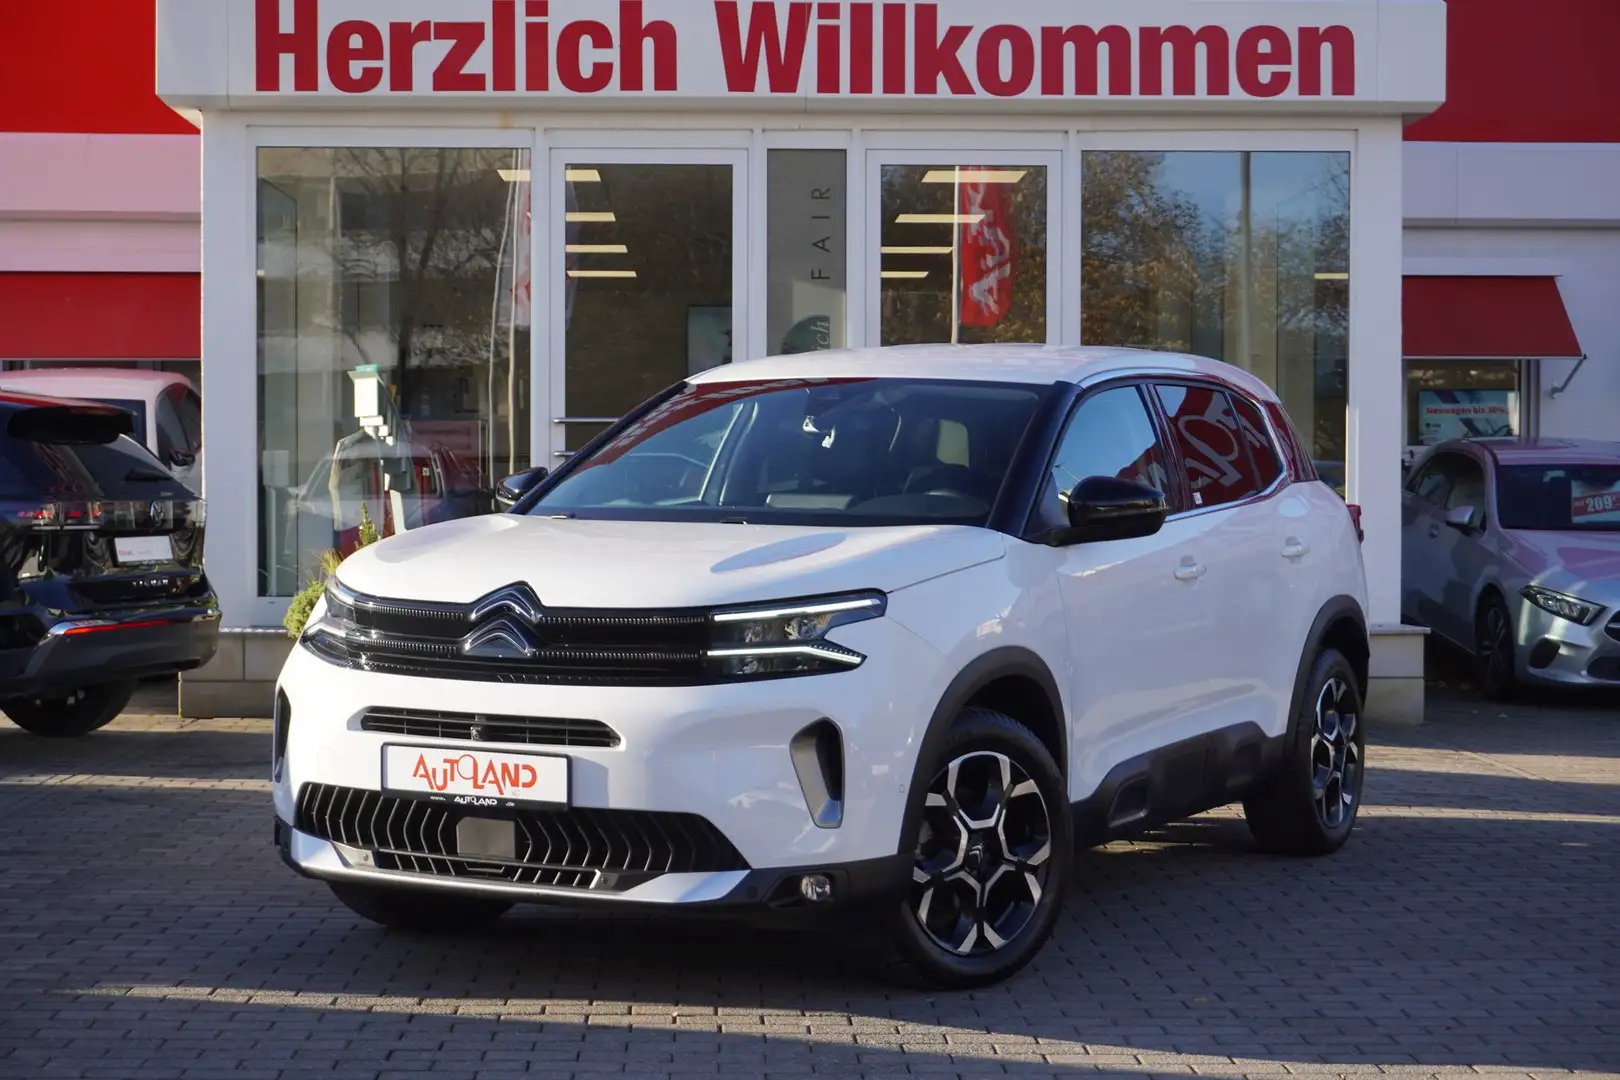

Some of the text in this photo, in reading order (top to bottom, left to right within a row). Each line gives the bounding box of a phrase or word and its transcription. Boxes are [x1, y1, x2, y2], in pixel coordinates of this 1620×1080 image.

[255, 0, 1356, 97] Herzlich Willkommen
[811, 187, 831, 280] FAIR
[413, 751, 538, 796] AUTOLAND
[454, 796, 498, 806] AUTOLAND
